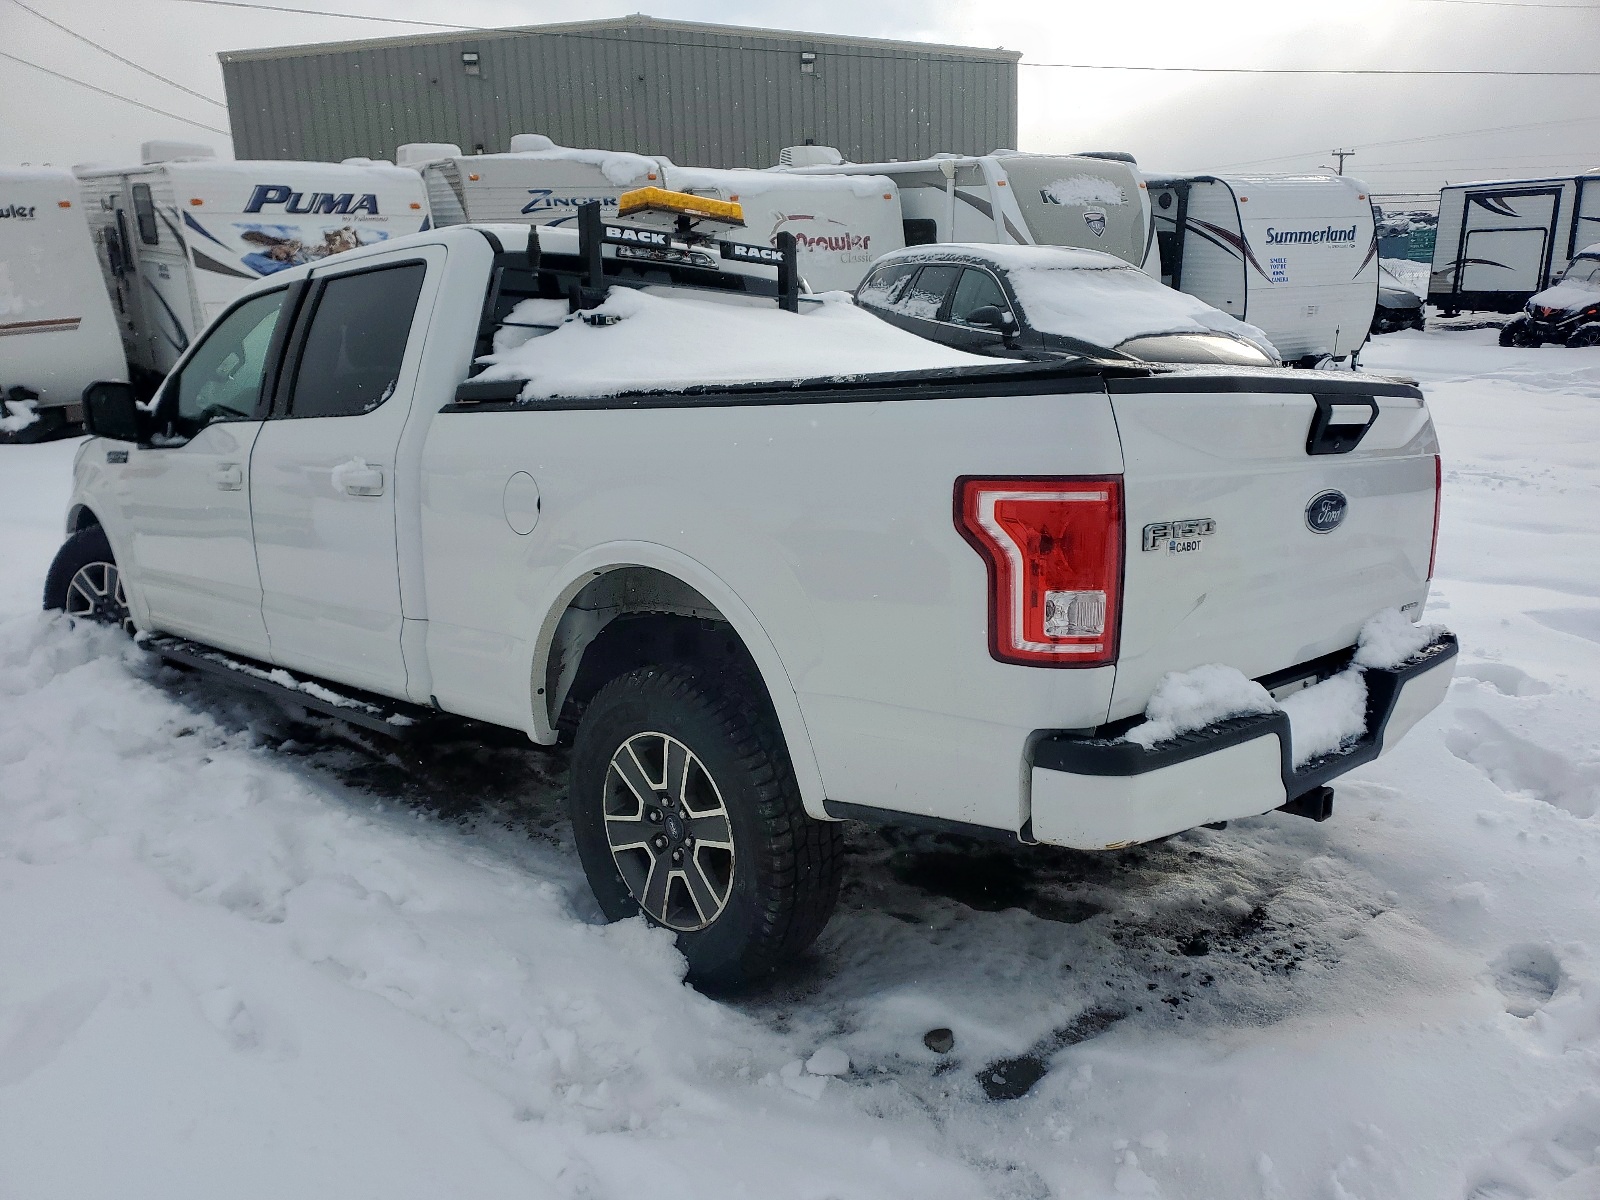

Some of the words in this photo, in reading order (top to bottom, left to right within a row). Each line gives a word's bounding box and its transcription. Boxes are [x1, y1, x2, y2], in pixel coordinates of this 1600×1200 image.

[243, 184, 379, 215] PUMA
[606, 226, 667, 245] BACK
[735, 245, 784, 261] RACK
[1266, 224, 1357, 244] Summerland
[840, 251, 873, 263] Classic
[1317, 499, 1342, 524] Ford
[1176, 540, 1202, 553] CABOT
